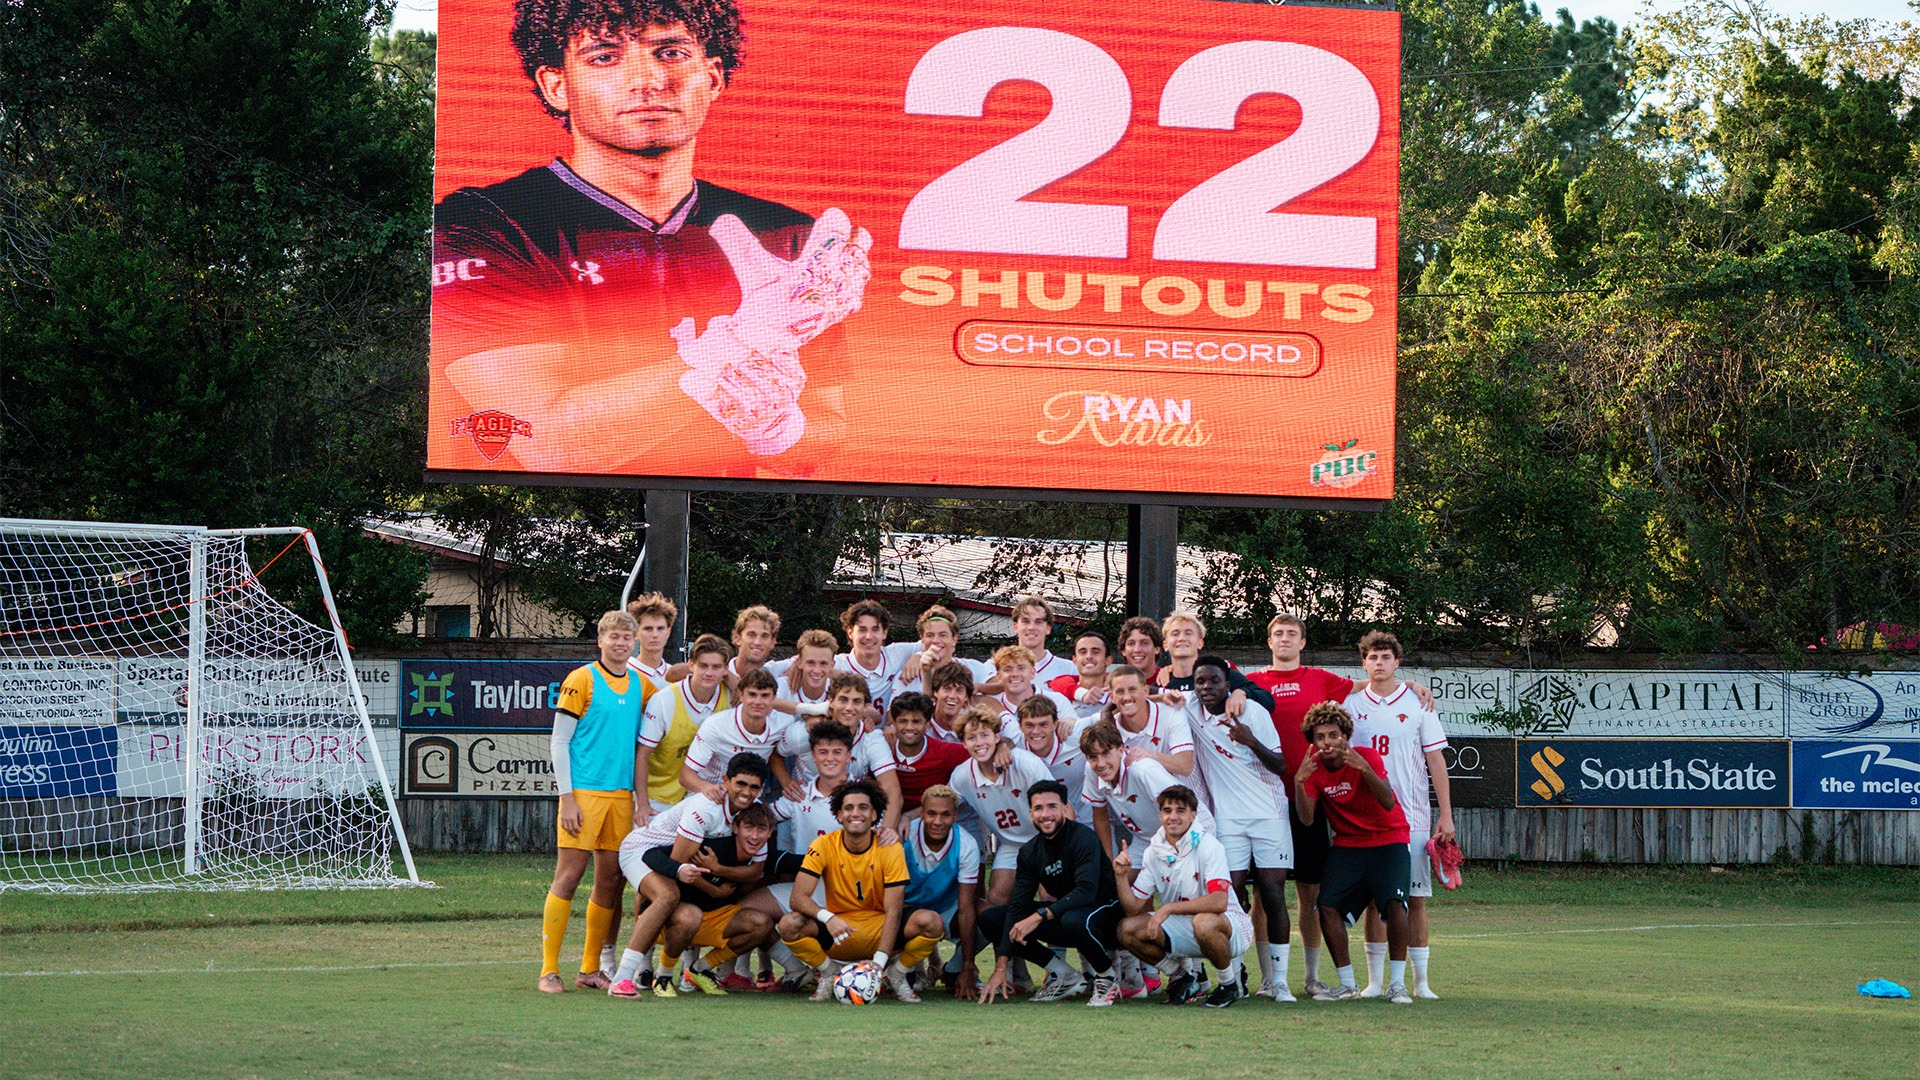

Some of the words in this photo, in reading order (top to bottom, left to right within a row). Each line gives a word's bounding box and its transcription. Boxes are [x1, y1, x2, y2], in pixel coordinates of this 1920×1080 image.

[898, 26, 1380, 270] 22
[898, 265, 1375, 324] SHUTOUTS
[973, 332, 1135, 359] SCHOOL
[1143, 340, 1302, 364] RECORD
[1036, 389, 1214, 448] Rivas
[1083, 394, 1192, 425] RYAN
[450, 417, 532, 438] FLAGLER
[1310, 450, 1377, 487] PBC
[34, 660, 53, 670] the
[57, 660, 112, 671] Business
[204, 663, 305, 687] Orthopedic
[1430, 676, 1500, 699] Brakel
[1589, 682, 1774, 711] CAPITAL
[1800, 691, 1853, 704] BAILEY
[1895, 680, 1916, 695] An
[50, 695, 85, 705] STREET
[1809, 704, 1870, 718] GROUP
[36, 709, 75, 718] FLORIDA
[1588, 719, 1672, 728] FINANCIAL
[1682, 720, 1774, 728] STRATEGIES
[24, 733, 53, 752] Inn
[1371, 734, 1390, 756] 18
[467, 737, 555, 775] Carm
[1580, 757, 1777, 791] SouthState
[1820, 777, 1856, 793] the
[995, 808, 1021, 830] 22
[855, 880, 865, 901] 1
